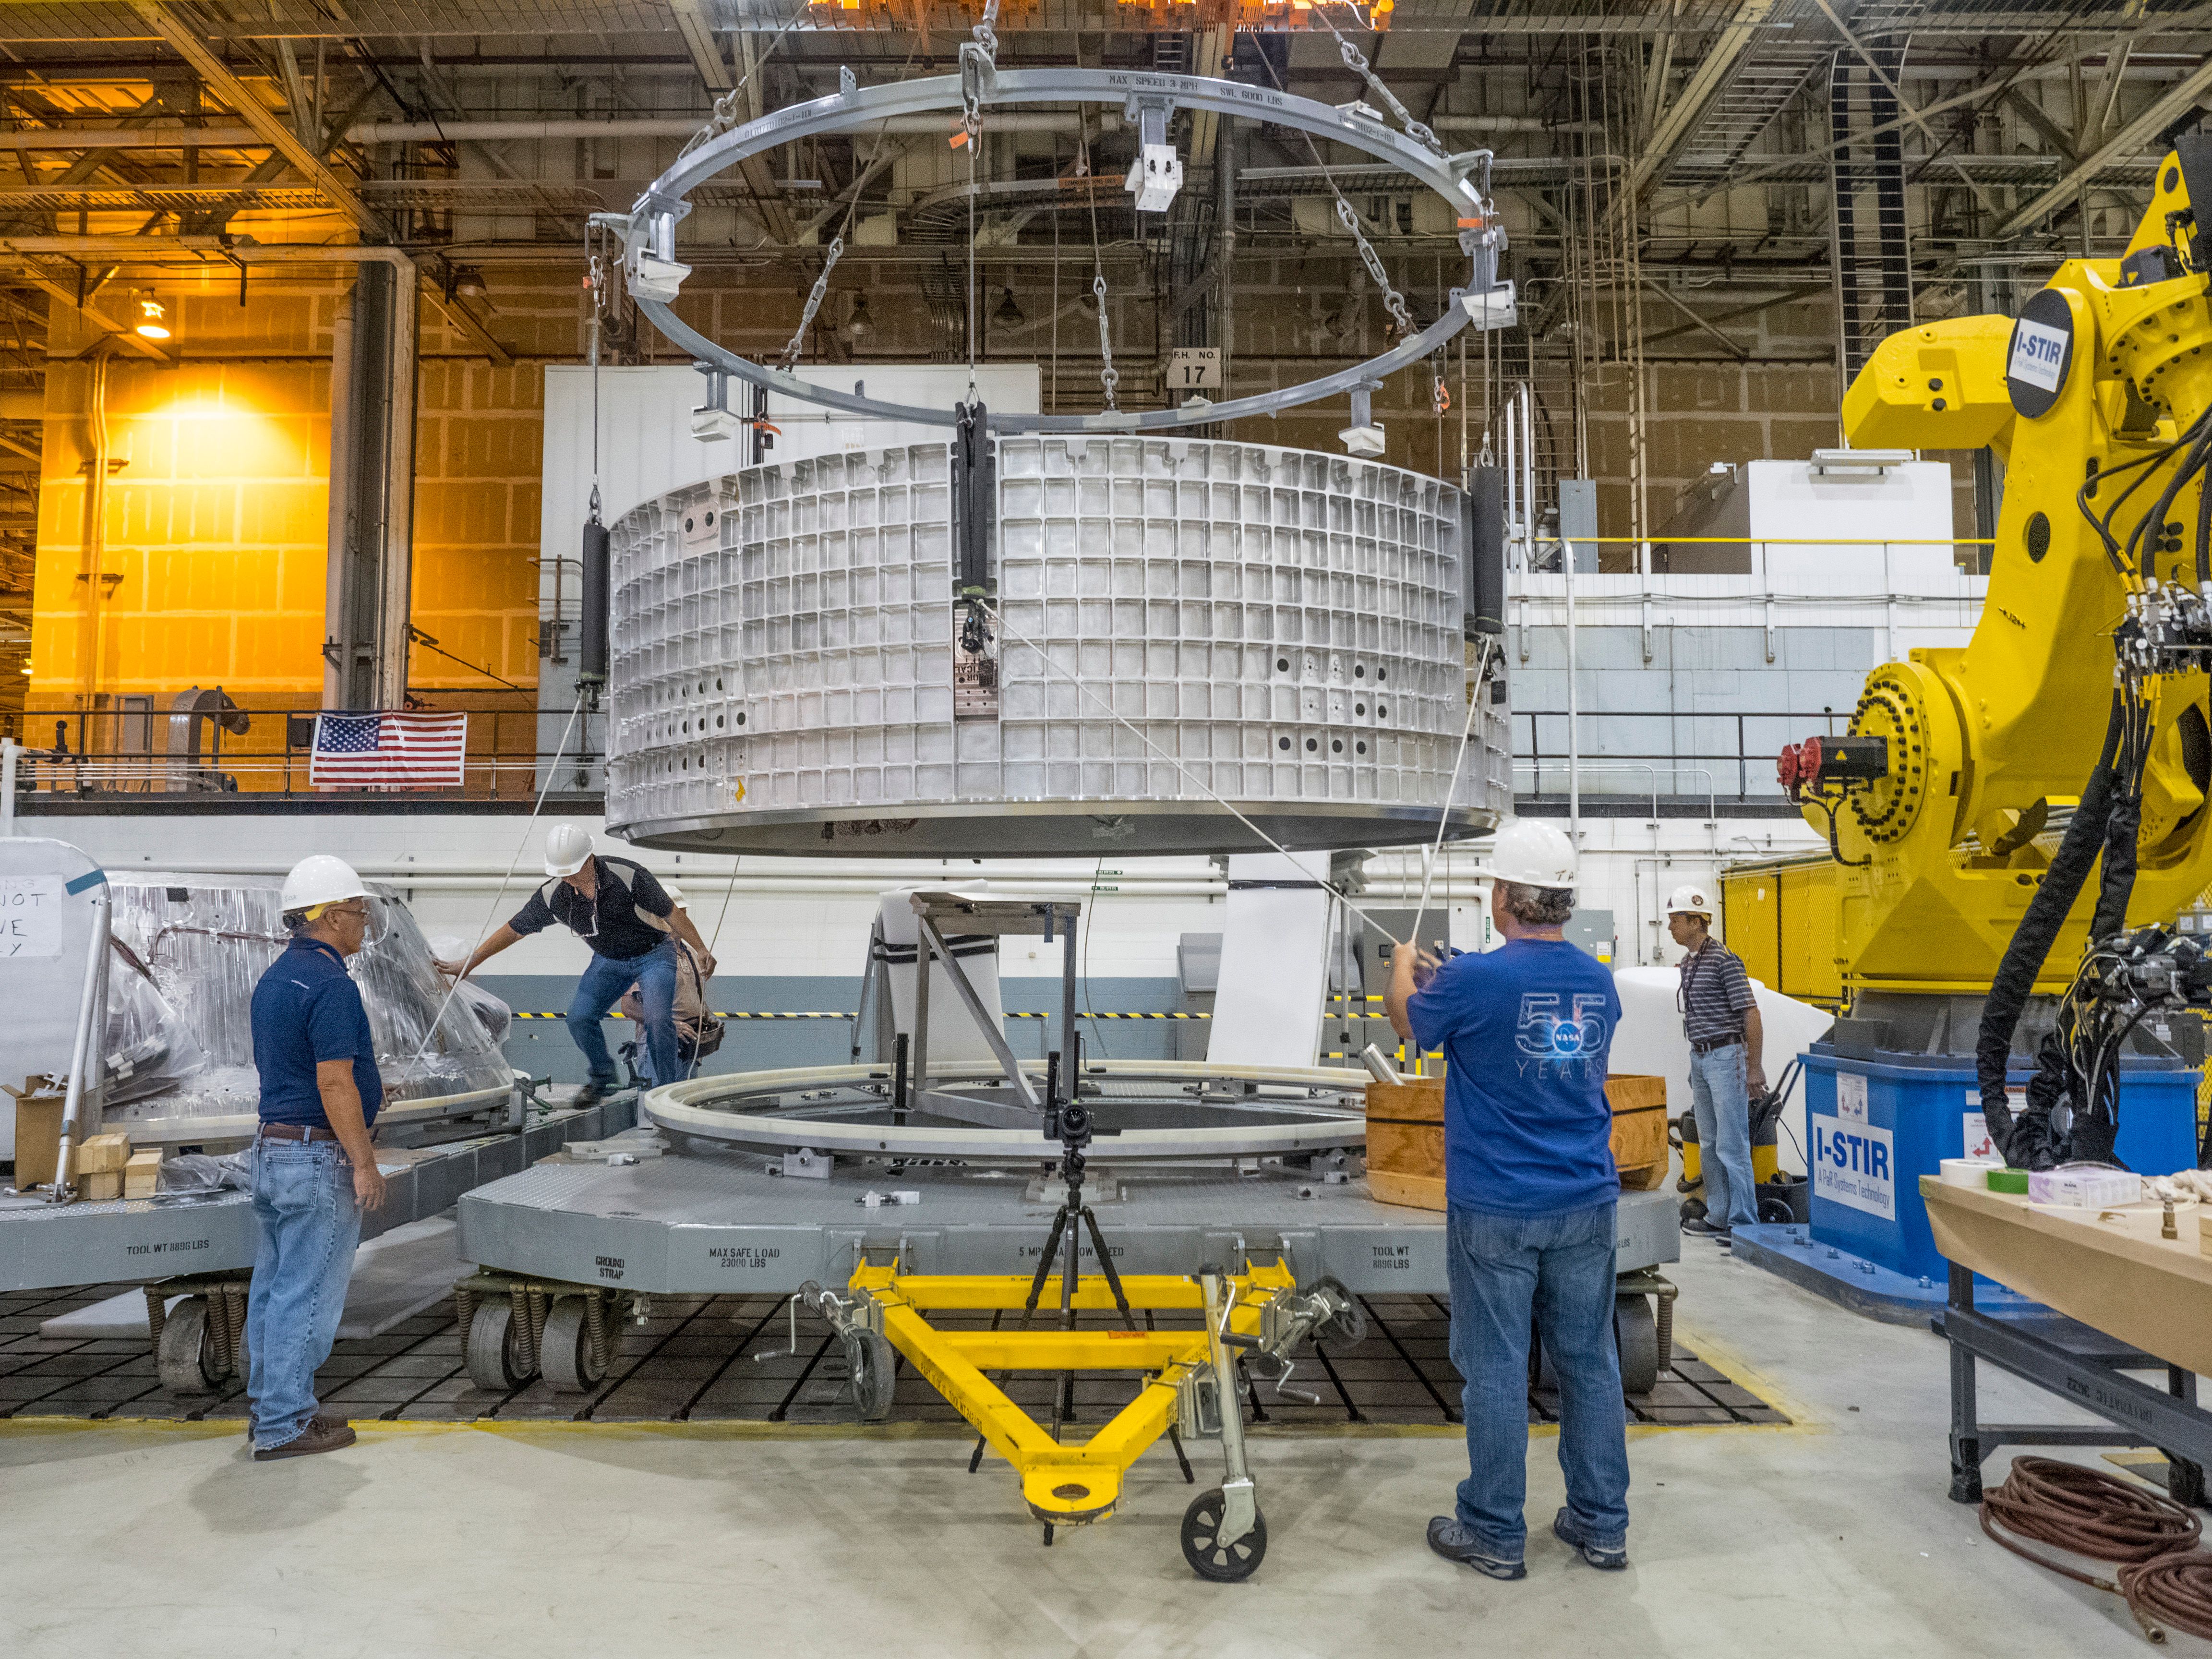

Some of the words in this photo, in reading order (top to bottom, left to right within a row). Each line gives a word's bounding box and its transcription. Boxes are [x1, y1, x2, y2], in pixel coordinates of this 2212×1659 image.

[1109, 75, 1127, 84] MAX
[1136, 76, 1166, 86] SPEED
[2017, 331, 2061, 365] I-STIR
[1184, 366, 1205, 384] 17
[1515, 992, 1607, 1058] 55
[1515, 1058, 1603, 1079] YEARS
[1816, 1127, 1889, 1181] I-STIR
[1818, 1167, 1822, 1184] A
[1823, 1169, 1833, 1188] PaR
[1834, 1172, 1857, 1196] Systems
[1858, 1180, 1890, 1209] Technology
[127, 1245, 151, 1255] TOOL
[154, 1243, 168, 1252] WT
[192, 1240, 209, 1250] LBS
[709, 1249, 728, 1257] MAX
[731, 1249, 751, 1258] SAFE
[1019, 1247, 1024, 1256] 5
[1373, 1246, 1394, 1256] TOOL
[1397, 1246, 1409, 1255] WT
[596, 1256, 624, 1268] GROUND
[721, 1258, 745, 1267] 23000
[750, 1258, 766, 1268] LBS
[1394, 1259, 1409, 1268] LBS
[600, 1268, 624, 1280] STRAP
